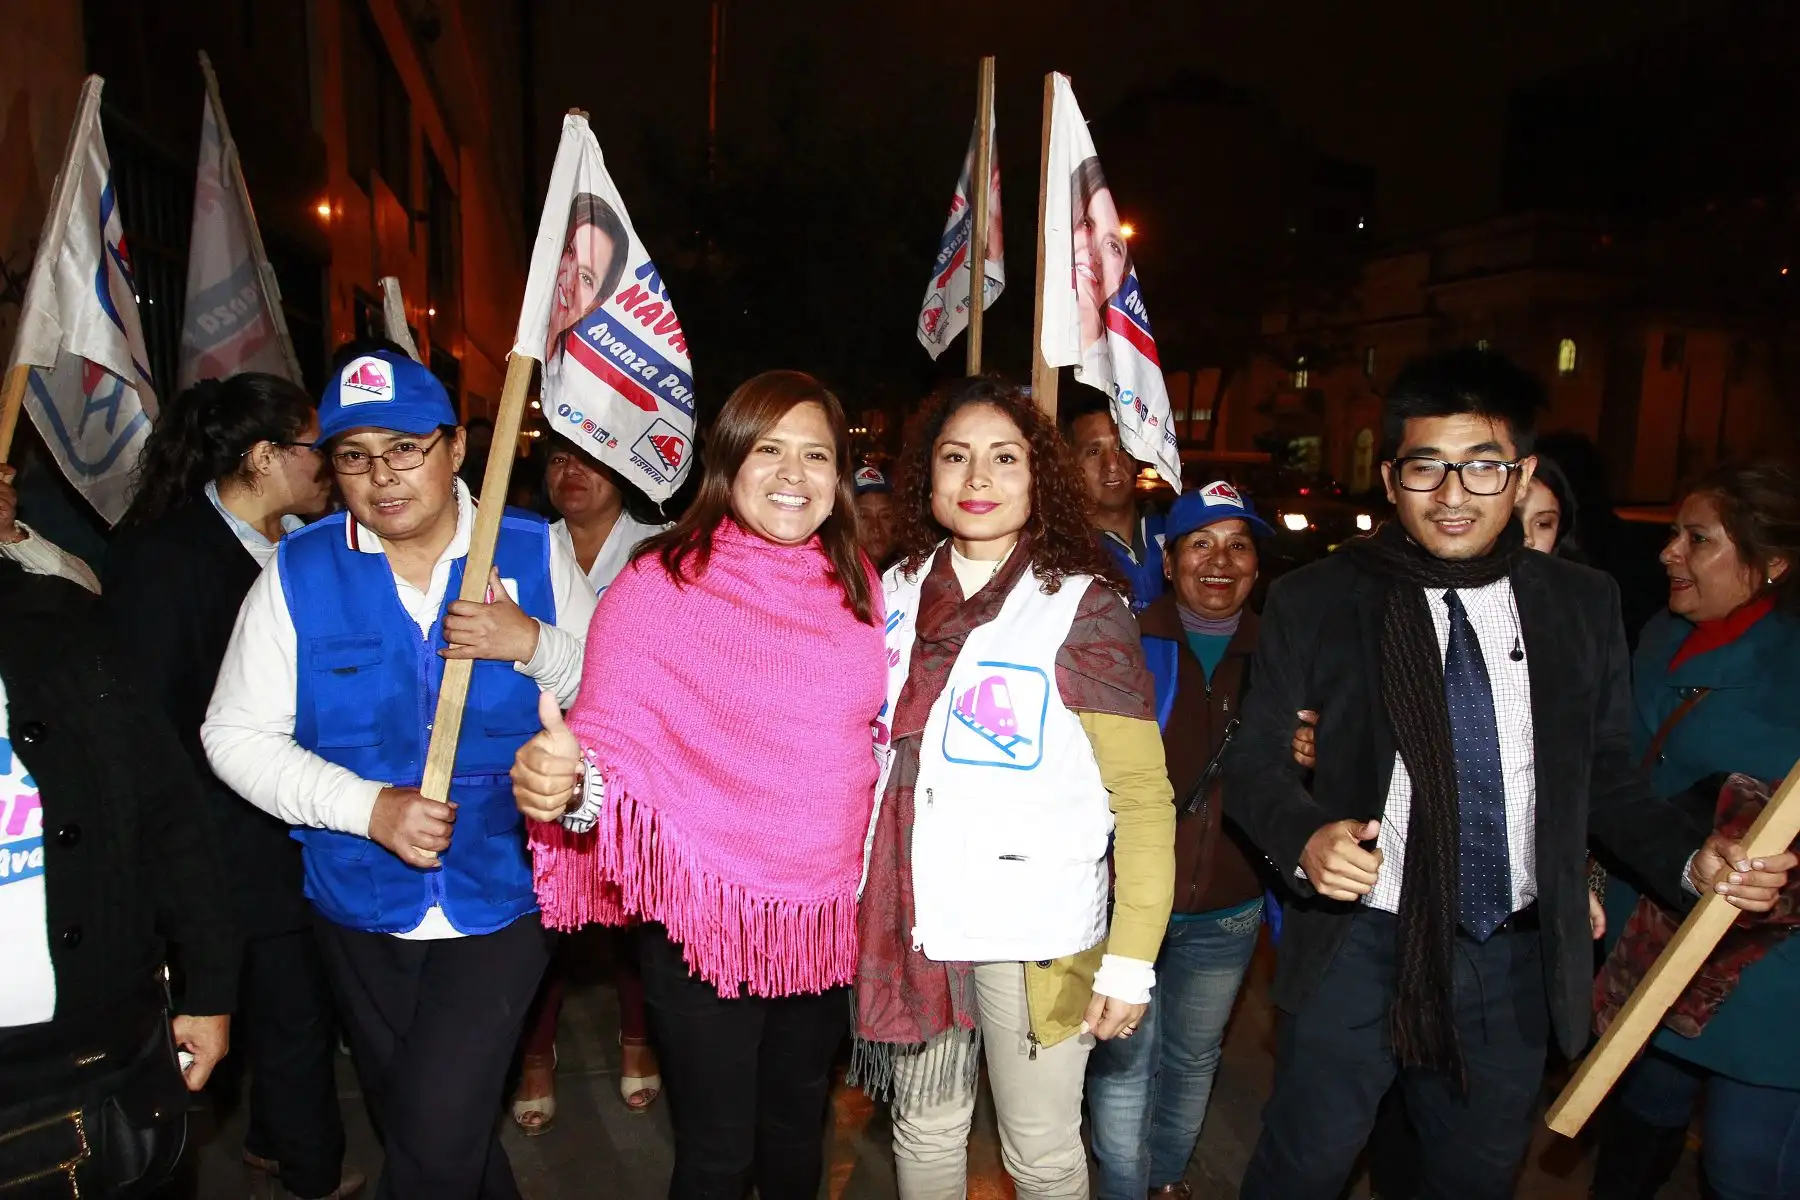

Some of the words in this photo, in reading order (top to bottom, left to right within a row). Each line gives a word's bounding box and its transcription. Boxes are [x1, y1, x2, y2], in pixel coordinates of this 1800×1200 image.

[615, 283, 692, 361] NAVA
[1125, 289, 1151, 327] Ava
[587, 322, 659, 380] Avanza
[629, 455, 665, 486] DISTRITAL
